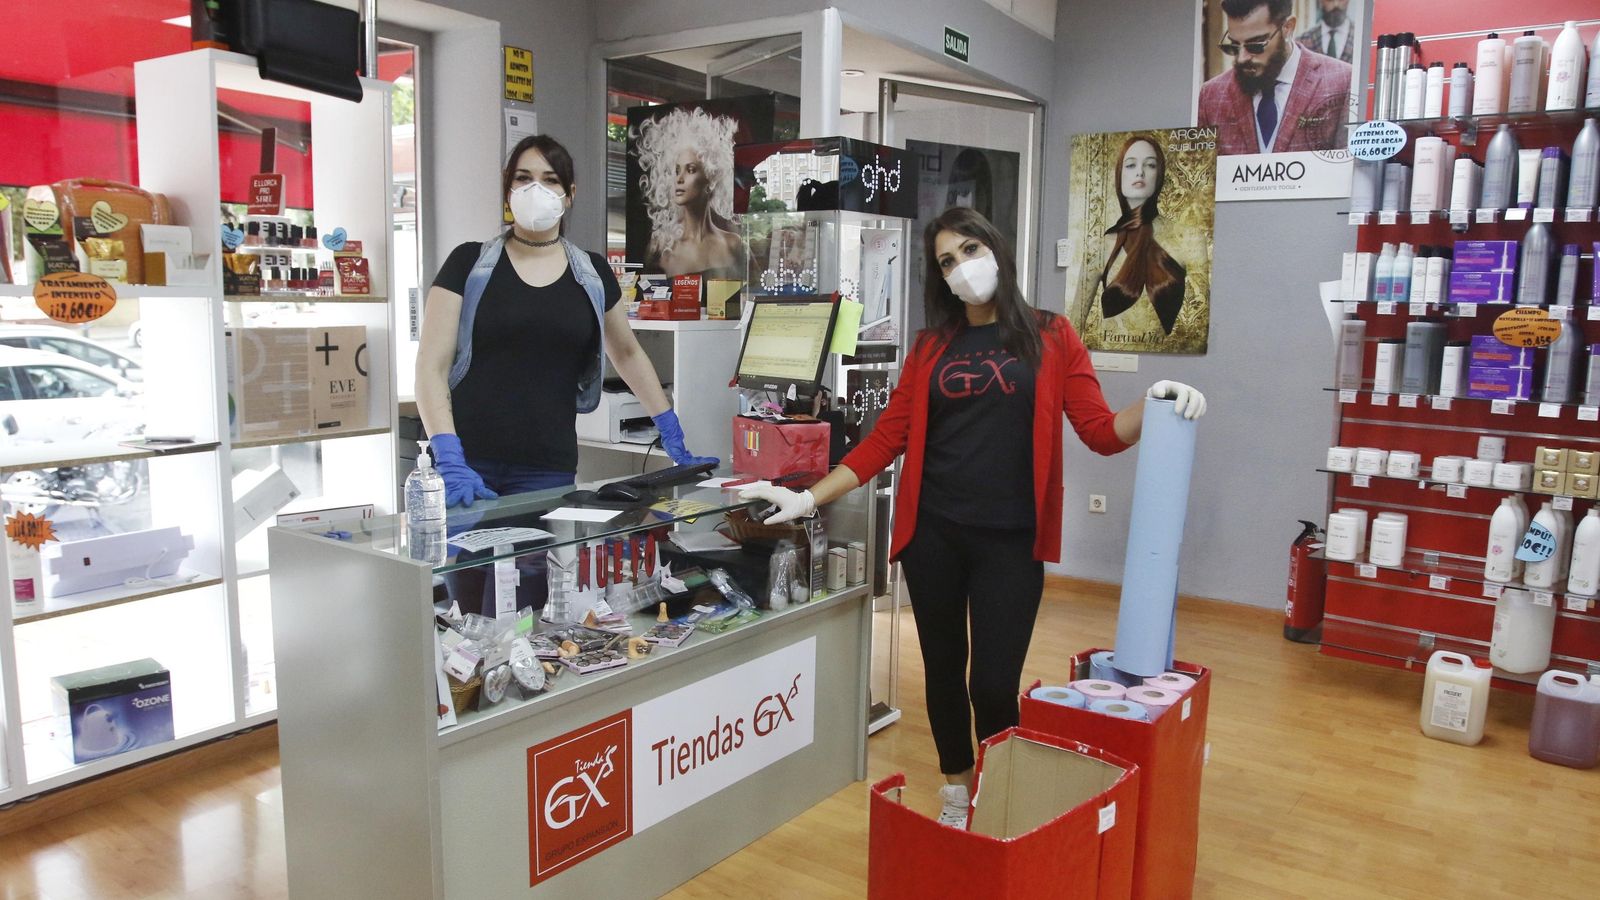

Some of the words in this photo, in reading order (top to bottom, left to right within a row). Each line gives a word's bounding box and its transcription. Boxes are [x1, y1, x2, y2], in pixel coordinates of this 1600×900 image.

[945, 33, 967, 55] SALIDA
[1169, 128, 1217, 141] ARGAN
[1350, 138, 1371, 146] ACEITE
[861, 154, 901, 203] ghd
[1232, 160, 1306, 184] AMARO
[40, 279, 108, 289] TRATAMIENTO
[51, 290, 102, 299] INTENSIVO
[329, 378, 357, 394] EVE
[852, 377, 889, 426] ghd
[135, 694, 171, 709] OZONE
[651, 714, 744, 786] Tiendas
[544, 840, 575, 862] GRUPO
